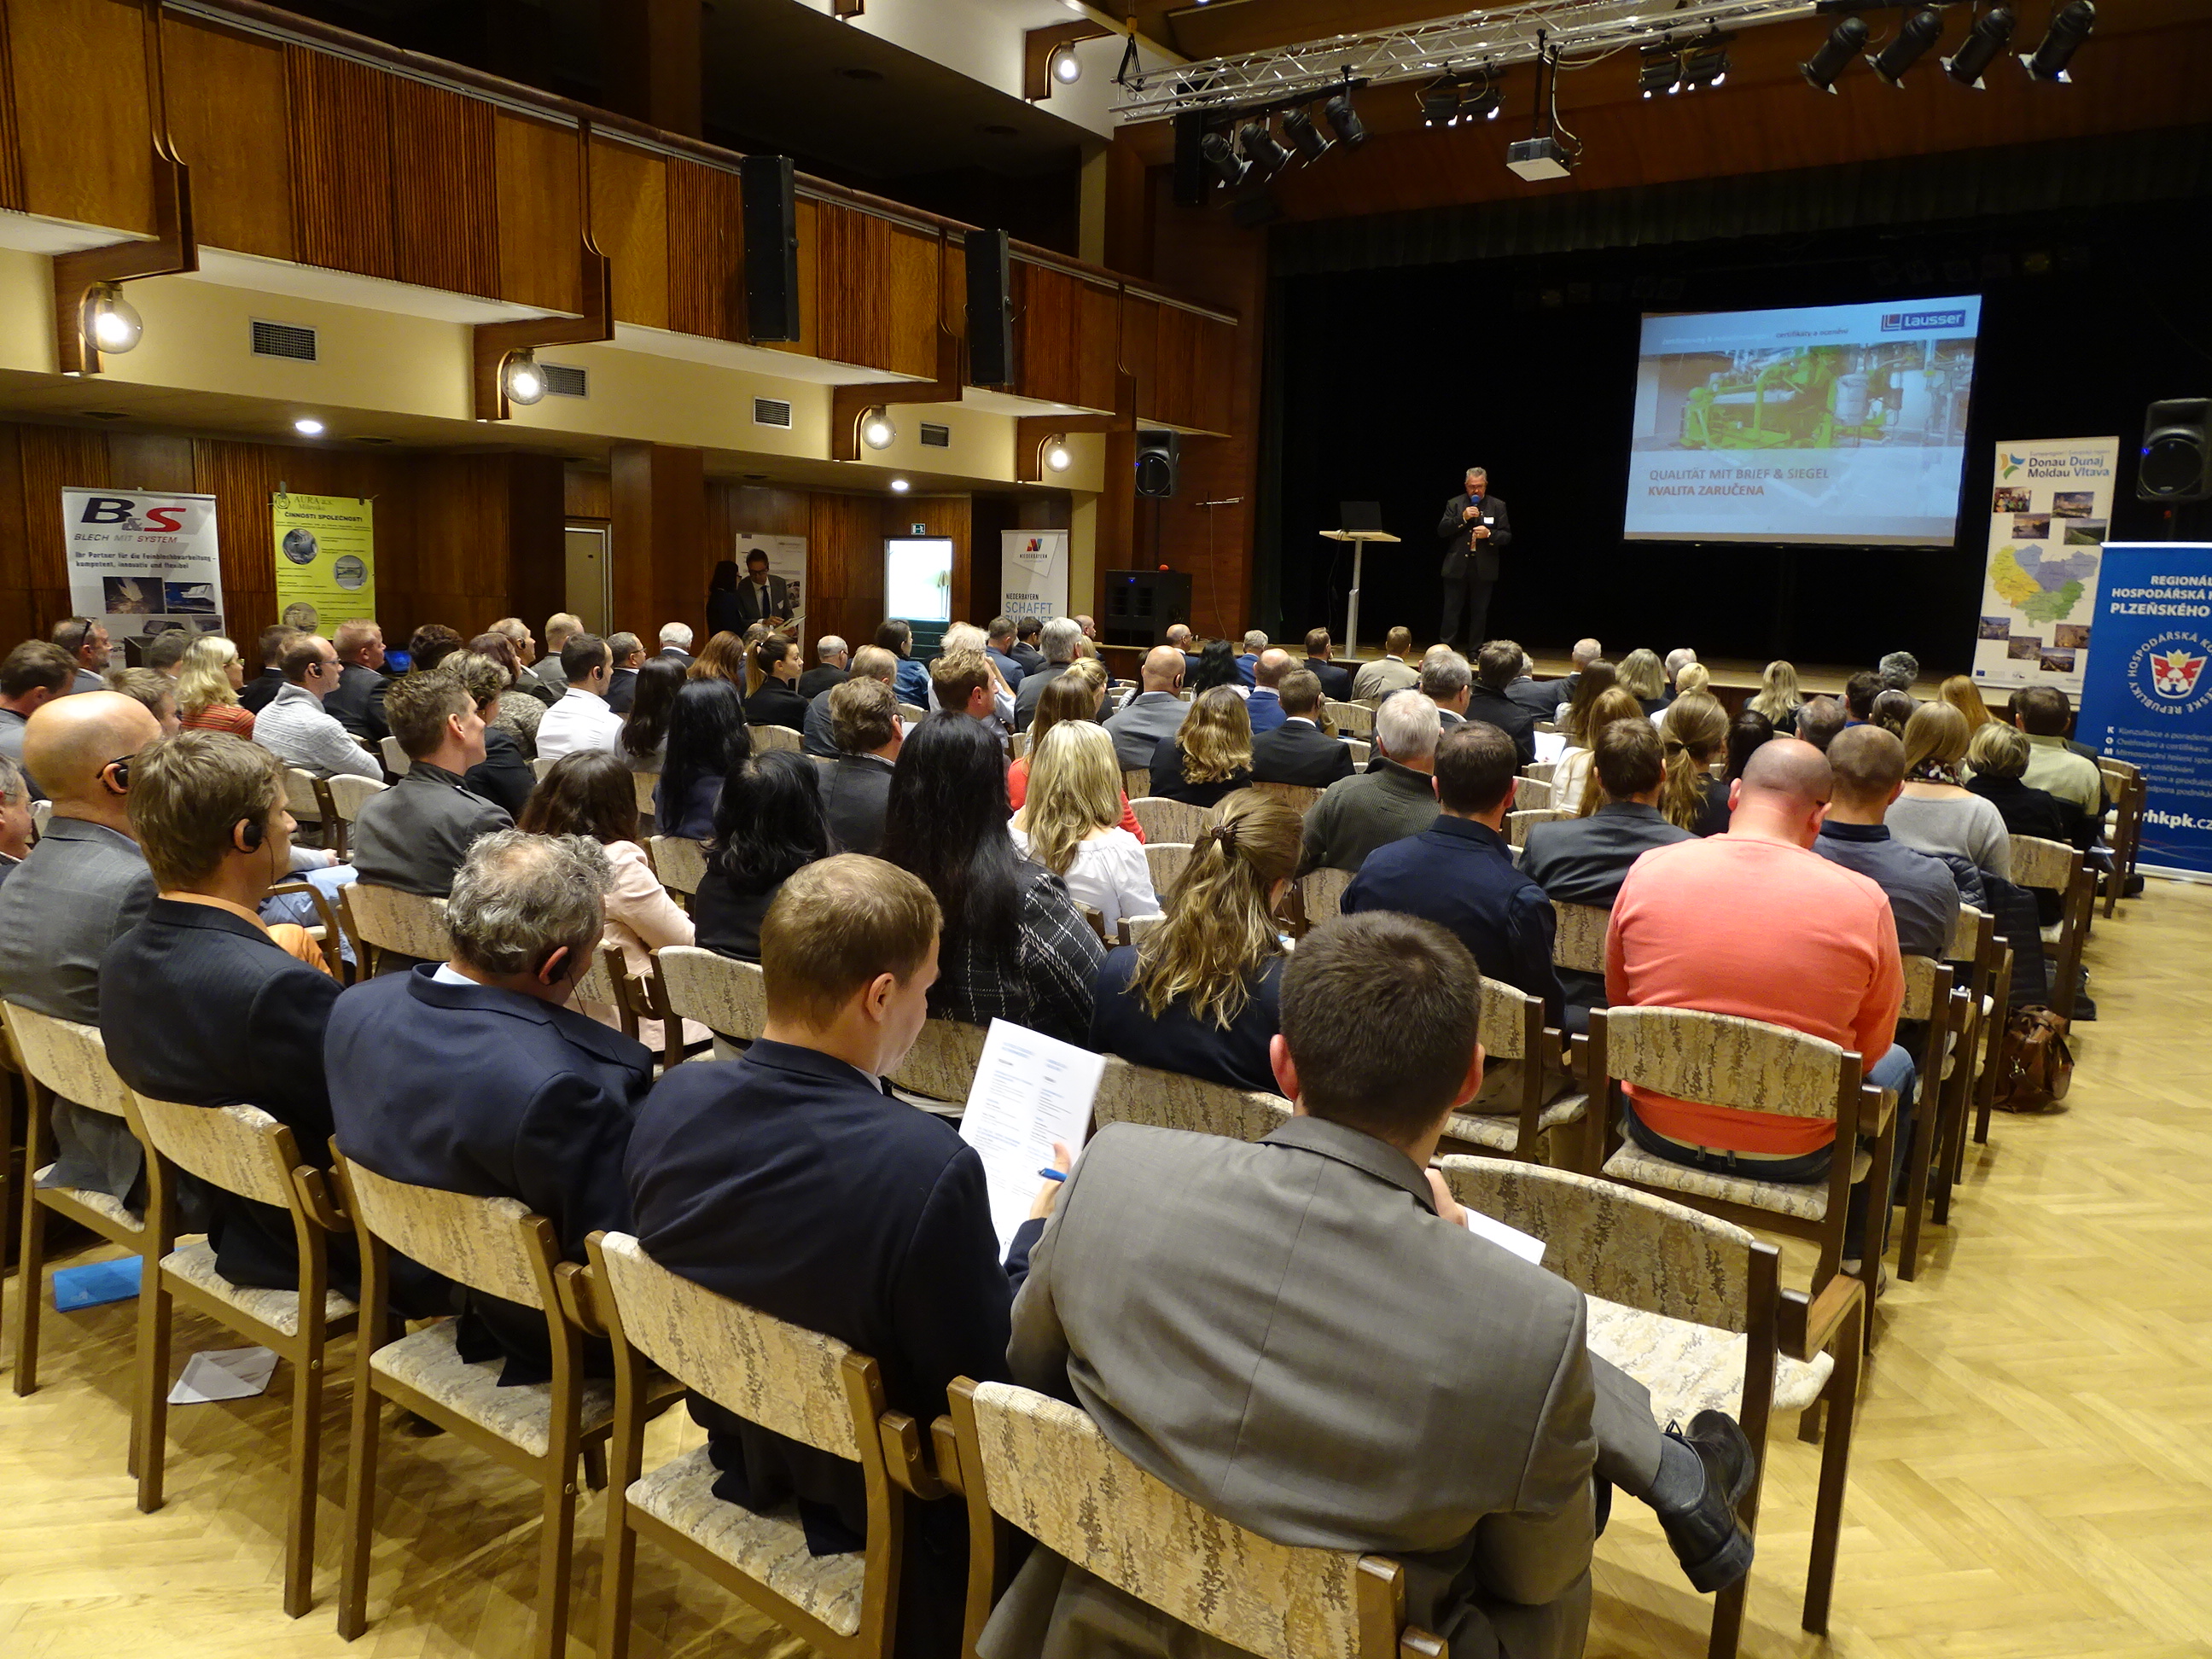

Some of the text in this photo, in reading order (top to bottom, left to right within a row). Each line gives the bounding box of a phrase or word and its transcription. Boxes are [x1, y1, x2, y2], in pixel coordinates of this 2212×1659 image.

[1904, 312, 1962, 328] Lausser
[2029, 456, 2104, 468] Donau Dunaj
[1650, 467, 1829, 480] QUALITÄT MIT BRIEF & SIEGEL
[2028, 467, 2110, 478] Moldau Vltava
[1648, 483, 1765, 496] KVALITA ZARUČENA
[81, 498, 187, 533] B&S
[74, 533, 109, 542] BLECH
[137, 535, 178, 544] SYSTEM
[1005, 602, 1053, 614] SCHAFFT
[2110, 602, 2210, 617] PLZEŇSKÉHO
[2128, 682, 2183, 714] REPUBLIKY
[2105, 736, 2114, 745] O
